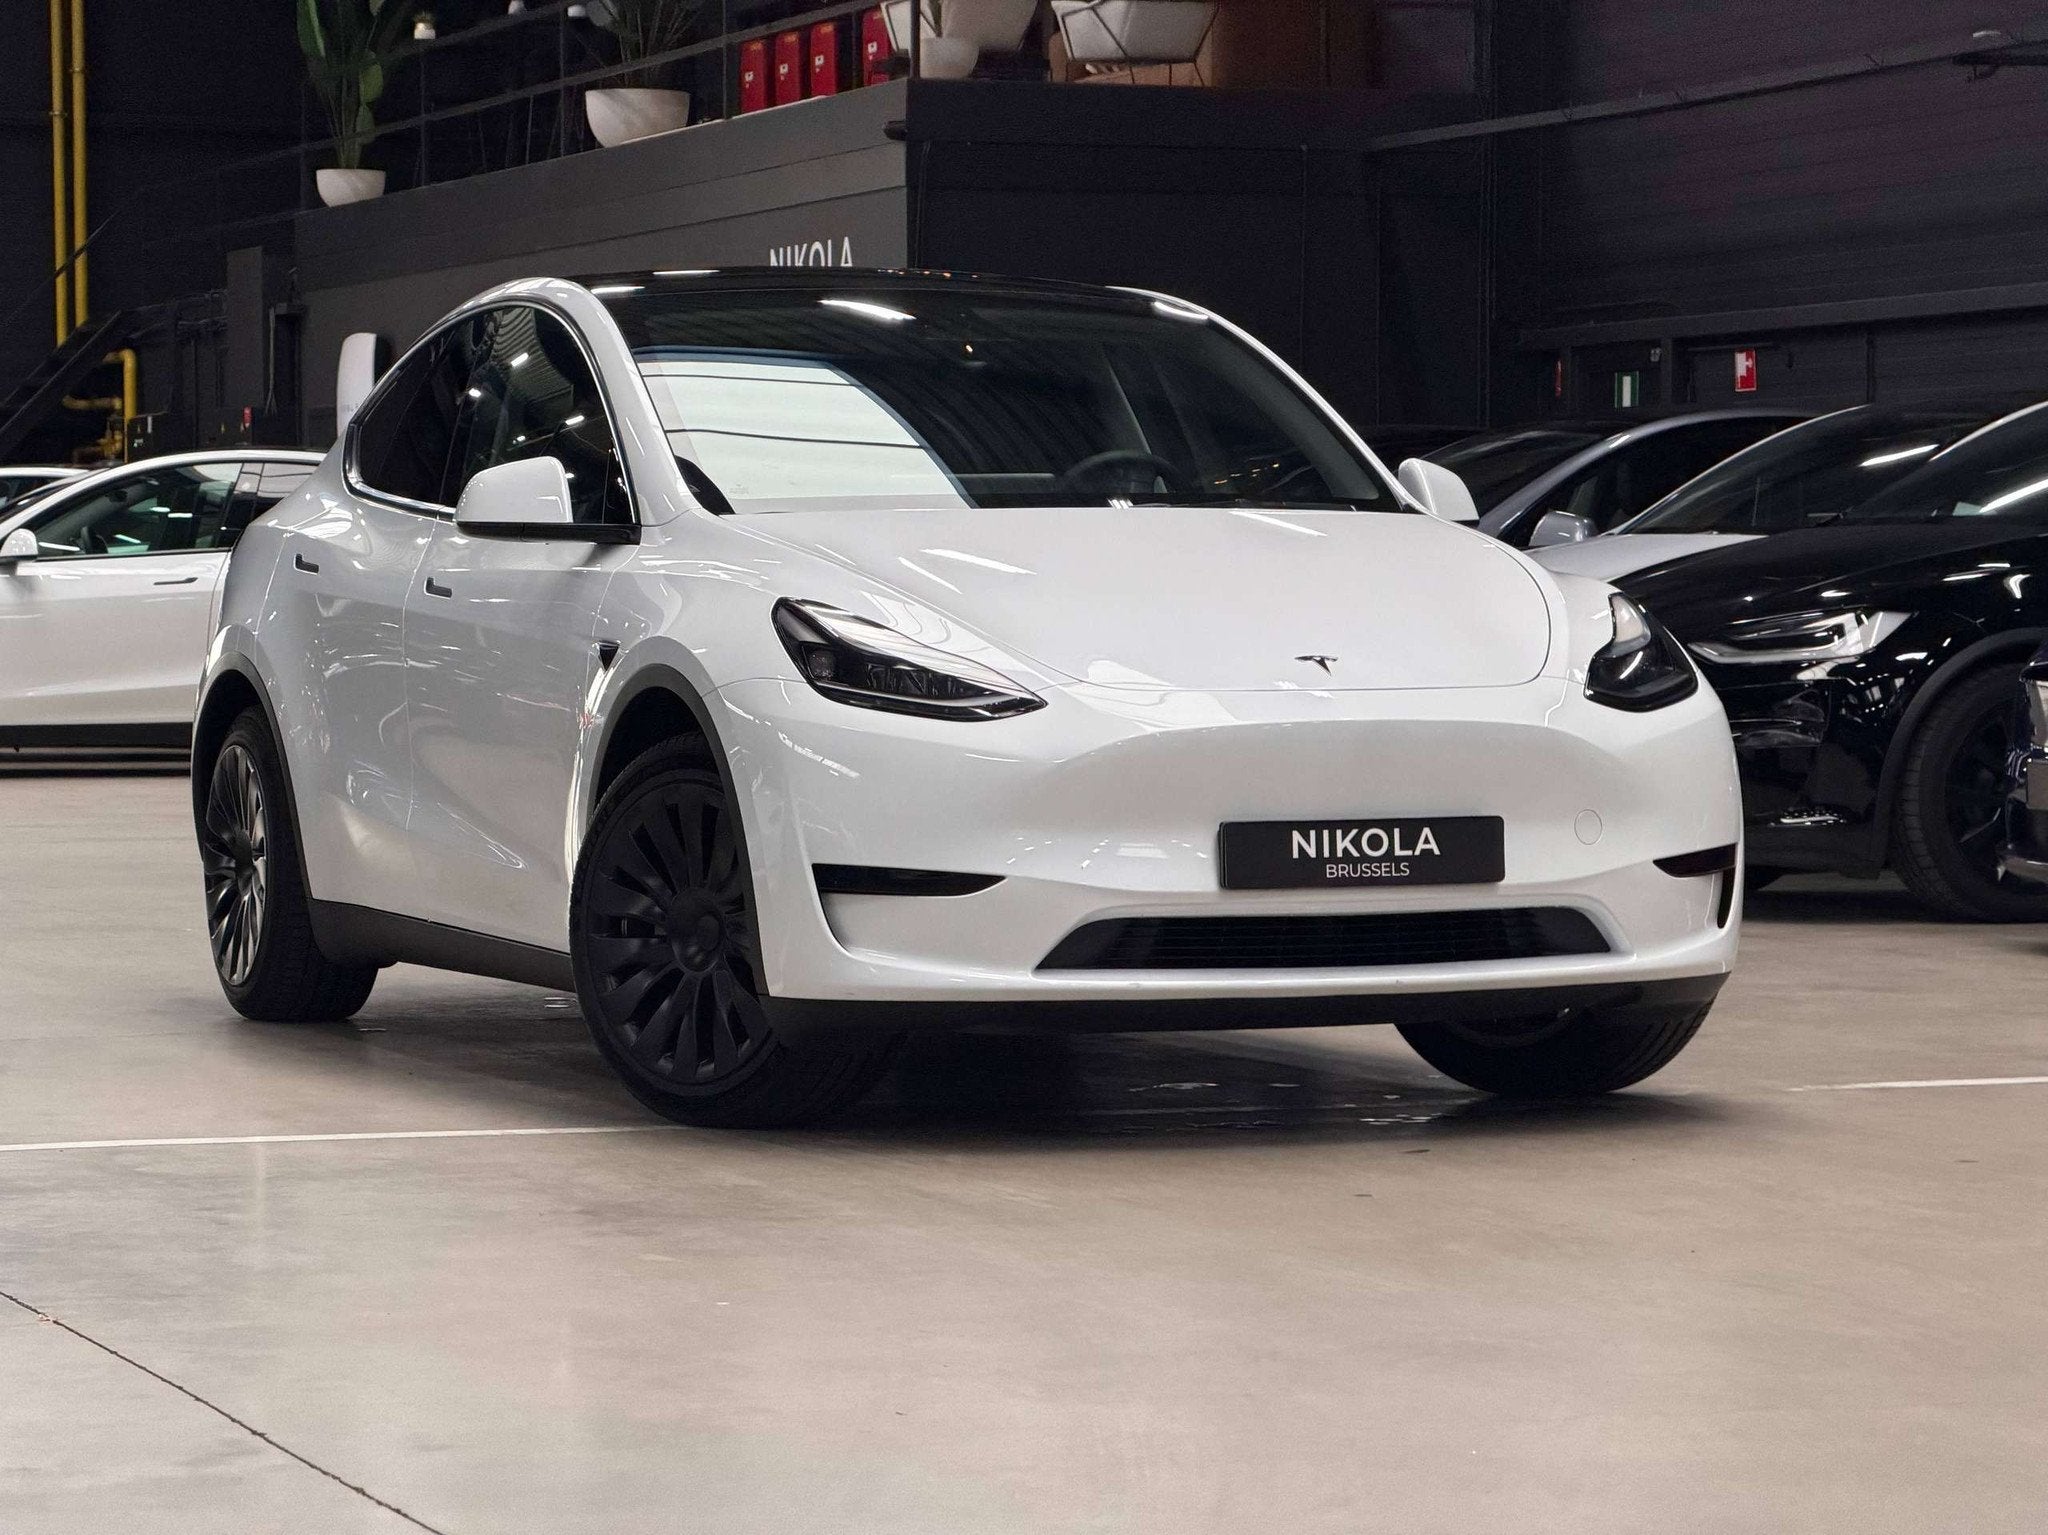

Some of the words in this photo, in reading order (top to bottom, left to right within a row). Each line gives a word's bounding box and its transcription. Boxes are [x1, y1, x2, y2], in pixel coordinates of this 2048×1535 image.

[769, 236, 853, 267] NIKOLA
[1292, 827, 1441, 859] NIKOLA
[1326, 862, 1410, 878] BRUSSELS
